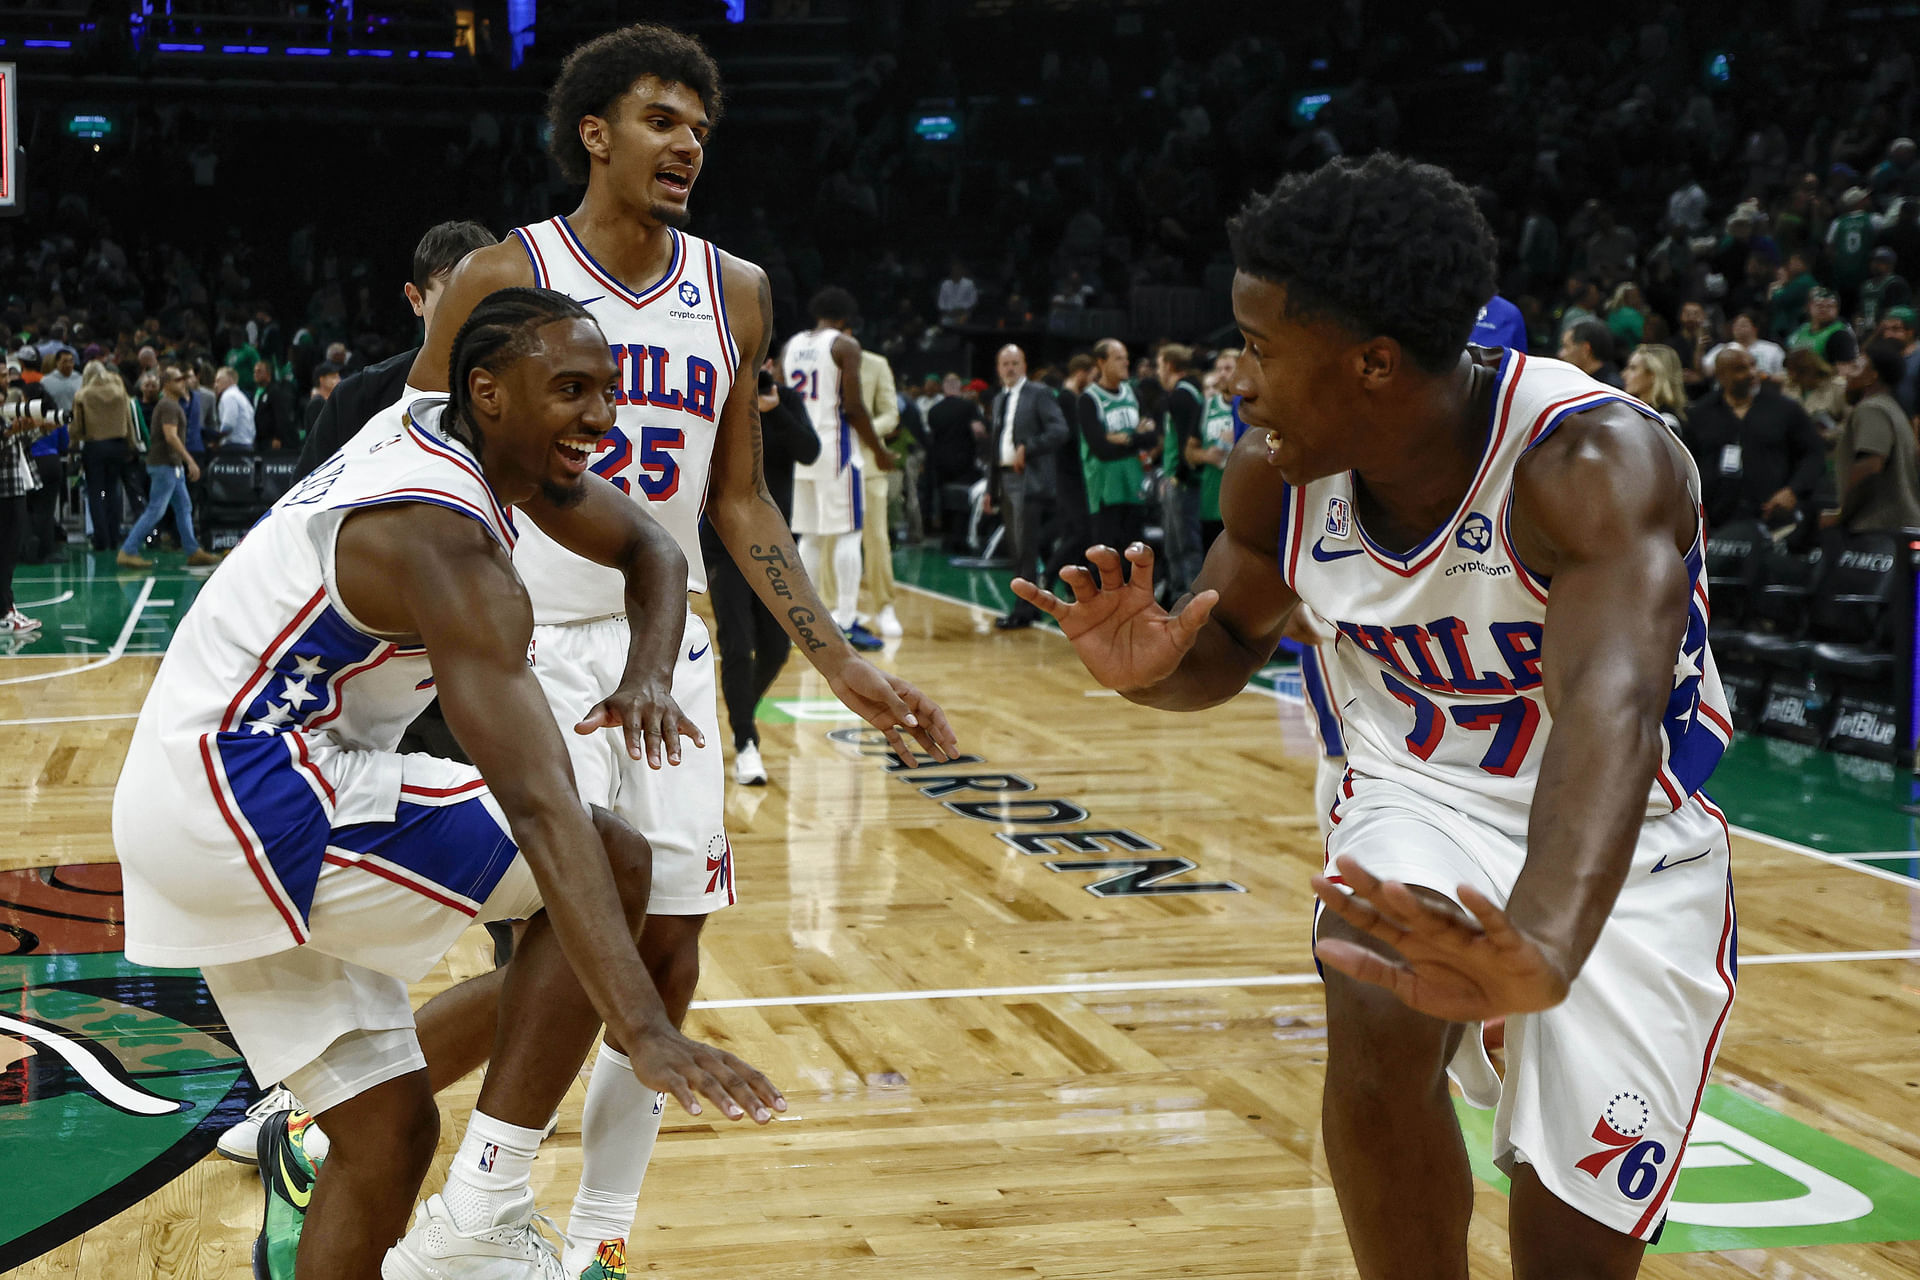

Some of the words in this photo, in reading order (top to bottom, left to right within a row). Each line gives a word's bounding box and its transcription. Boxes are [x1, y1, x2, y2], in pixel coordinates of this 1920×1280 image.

[669, 309, 714, 321] crypto.com
[791, 369, 819, 401] 21
[214, 464, 251, 474] PIMCO
[587, 425, 686, 502] 25
[1445, 560, 1512, 577] crypto.com
[1839, 550, 1894, 573] PIMCO
[750, 544, 793, 600] Fear
[787, 606, 828, 653] God
[1830, 707, 1897, 745] jetBlue
[1574, 1114, 1667, 1201] 76
